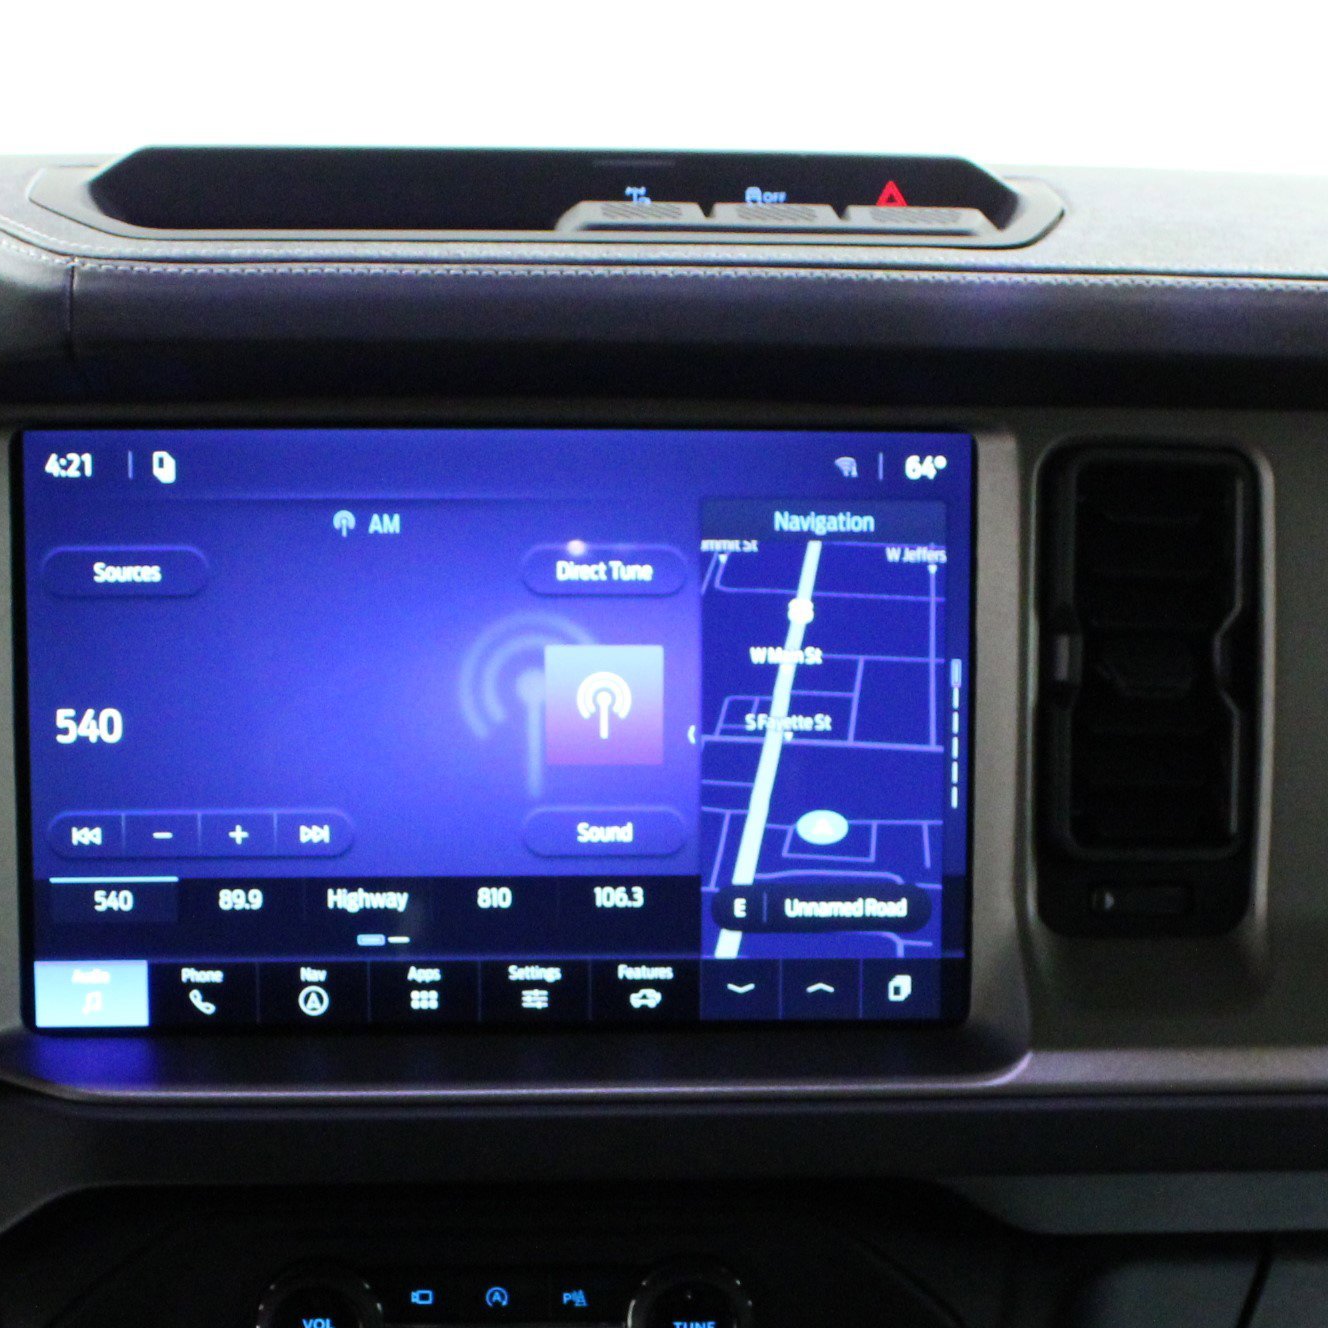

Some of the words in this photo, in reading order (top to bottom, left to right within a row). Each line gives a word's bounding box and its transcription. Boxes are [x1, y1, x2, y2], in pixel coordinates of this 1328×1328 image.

[44, 452, 93, 478] 4:21
[368, 512, 401, 534] AM
[774, 511, 875, 536] Navigation
[885, 547, 901, 563] W
[93, 561, 162, 584] Sources
[555, 560, 606, 582] Direct
[609, 560, 653, 582] Tune
[749, 646, 767, 665] W
[804, 646, 823, 665] St
[55, 708, 123, 745] 540
[745, 713, 757, 731] S
[757, 713, 814, 734] Fayette
[814, 713, 832, 731] St
[577, 822, 634, 843] Sound
[94, 890, 134, 911] 540
[218, 889, 263, 911] 89.9
[327, 888, 408, 913] Highway
[477, 887, 512, 909] 810
[594, 886, 645, 908] 106.3
[733, 898, 747, 917] E
[784, 898, 864, 918] Unnamed
[865, 898, 907, 917] Road
[181, 966, 223, 985] Phone
[299, 966, 327, 984] Nav
[407, 966, 441, 986] Apps
[508, 965, 561, 984] Settings
[617, 964, 673, 981] Features
